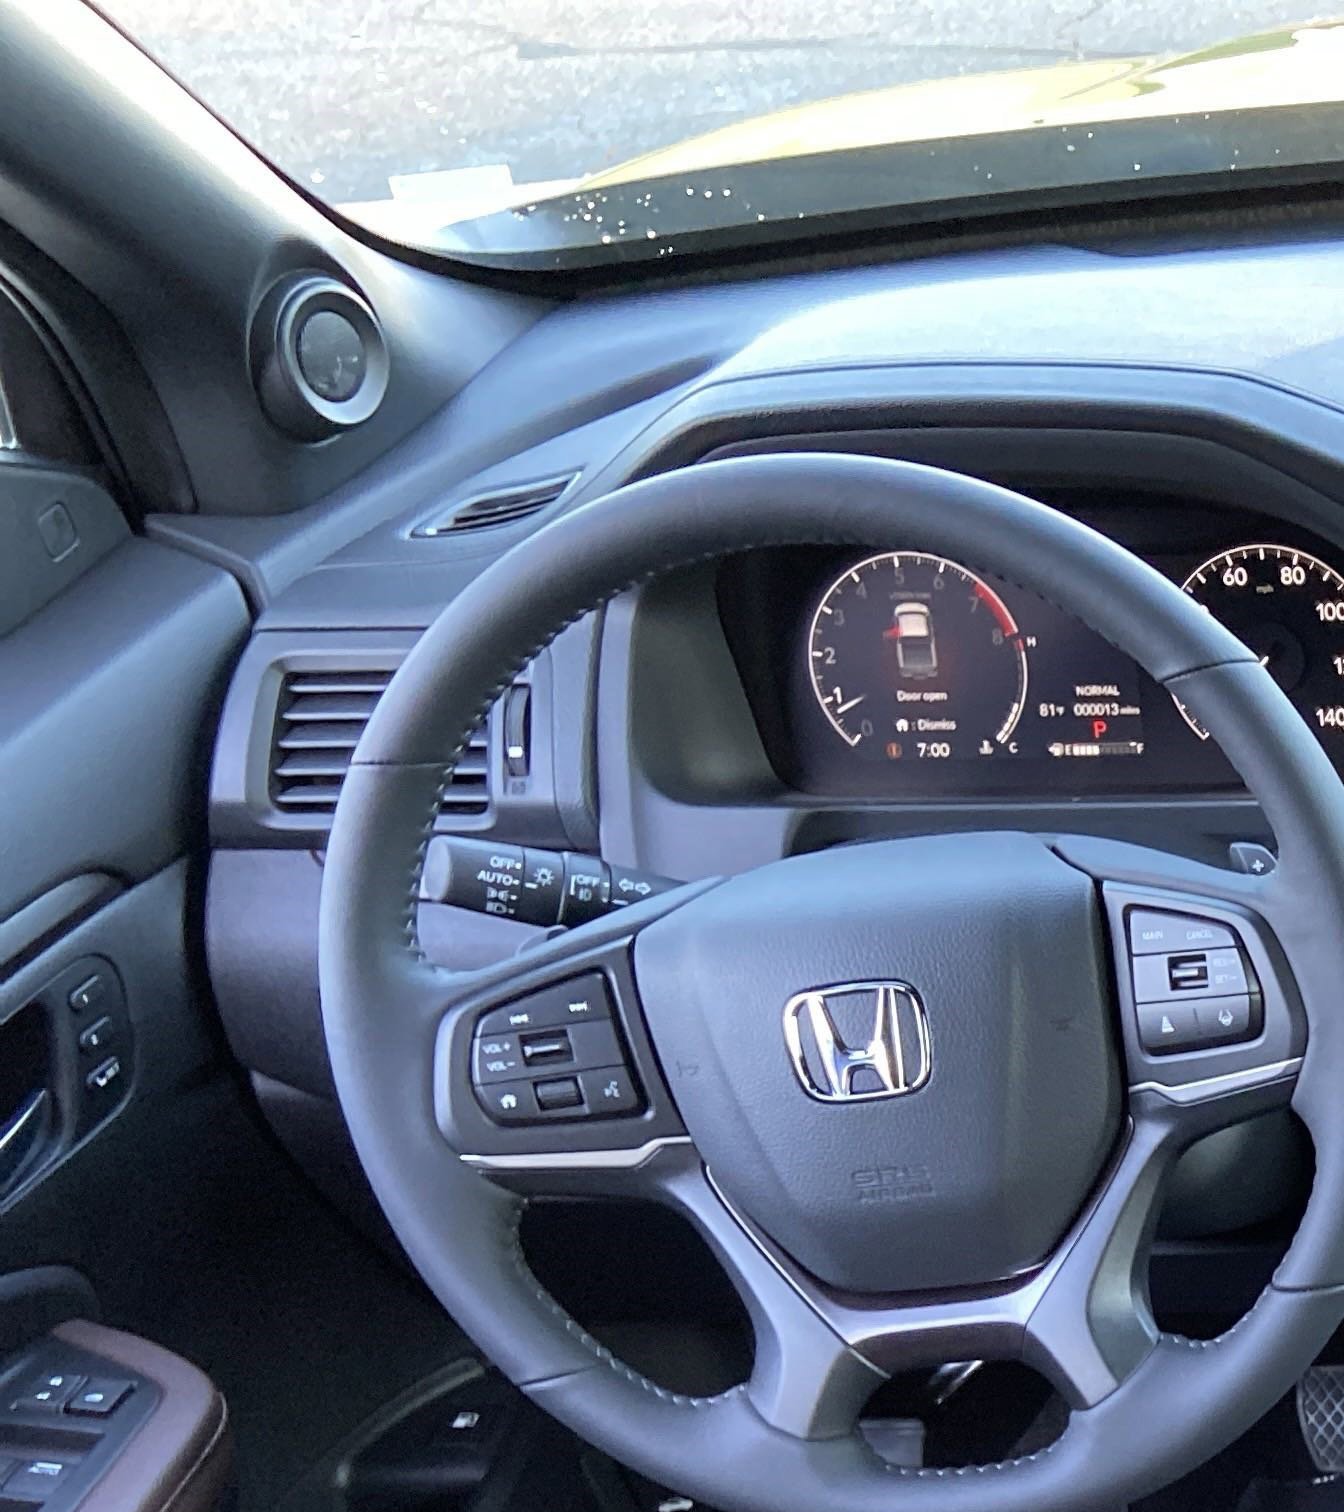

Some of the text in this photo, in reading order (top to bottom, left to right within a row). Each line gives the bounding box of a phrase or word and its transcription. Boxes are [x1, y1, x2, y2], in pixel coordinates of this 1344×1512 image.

[895, 568, 904, 585] 5
[934, 575, 944, 590] 6
[1222, 568, 1248, 586] 60
[1280, 567, 1305, 585] 80
[856, 583, 867, 599] 4
[969, 597, 979, 613] 7
[834, 609, 845, 625] 3
[1026, 636, 1036, 647] H
[824, 648, 837, 664] 2
[833, 686, 843, 703] 1
[897, 690, 947, 702] Door open
[1076, 685, 1120, 696] NORMAL
[1074, 703, 1119, 716] 000013
[918, 719, 956, 731] Dismiss
[1094, 720, 1107, 738] P
[917, 743, 951, 758] 7:00
[1009, 743, 1018, 754] C
[490, 856, 515, 869] OFF
[477, 870, 513, 886] AUTO
[576, 875, 600, 887] OFF
[1142, 931, 1163, 940] MAIN
[1186, 930, 1214, 940] CANCEL
